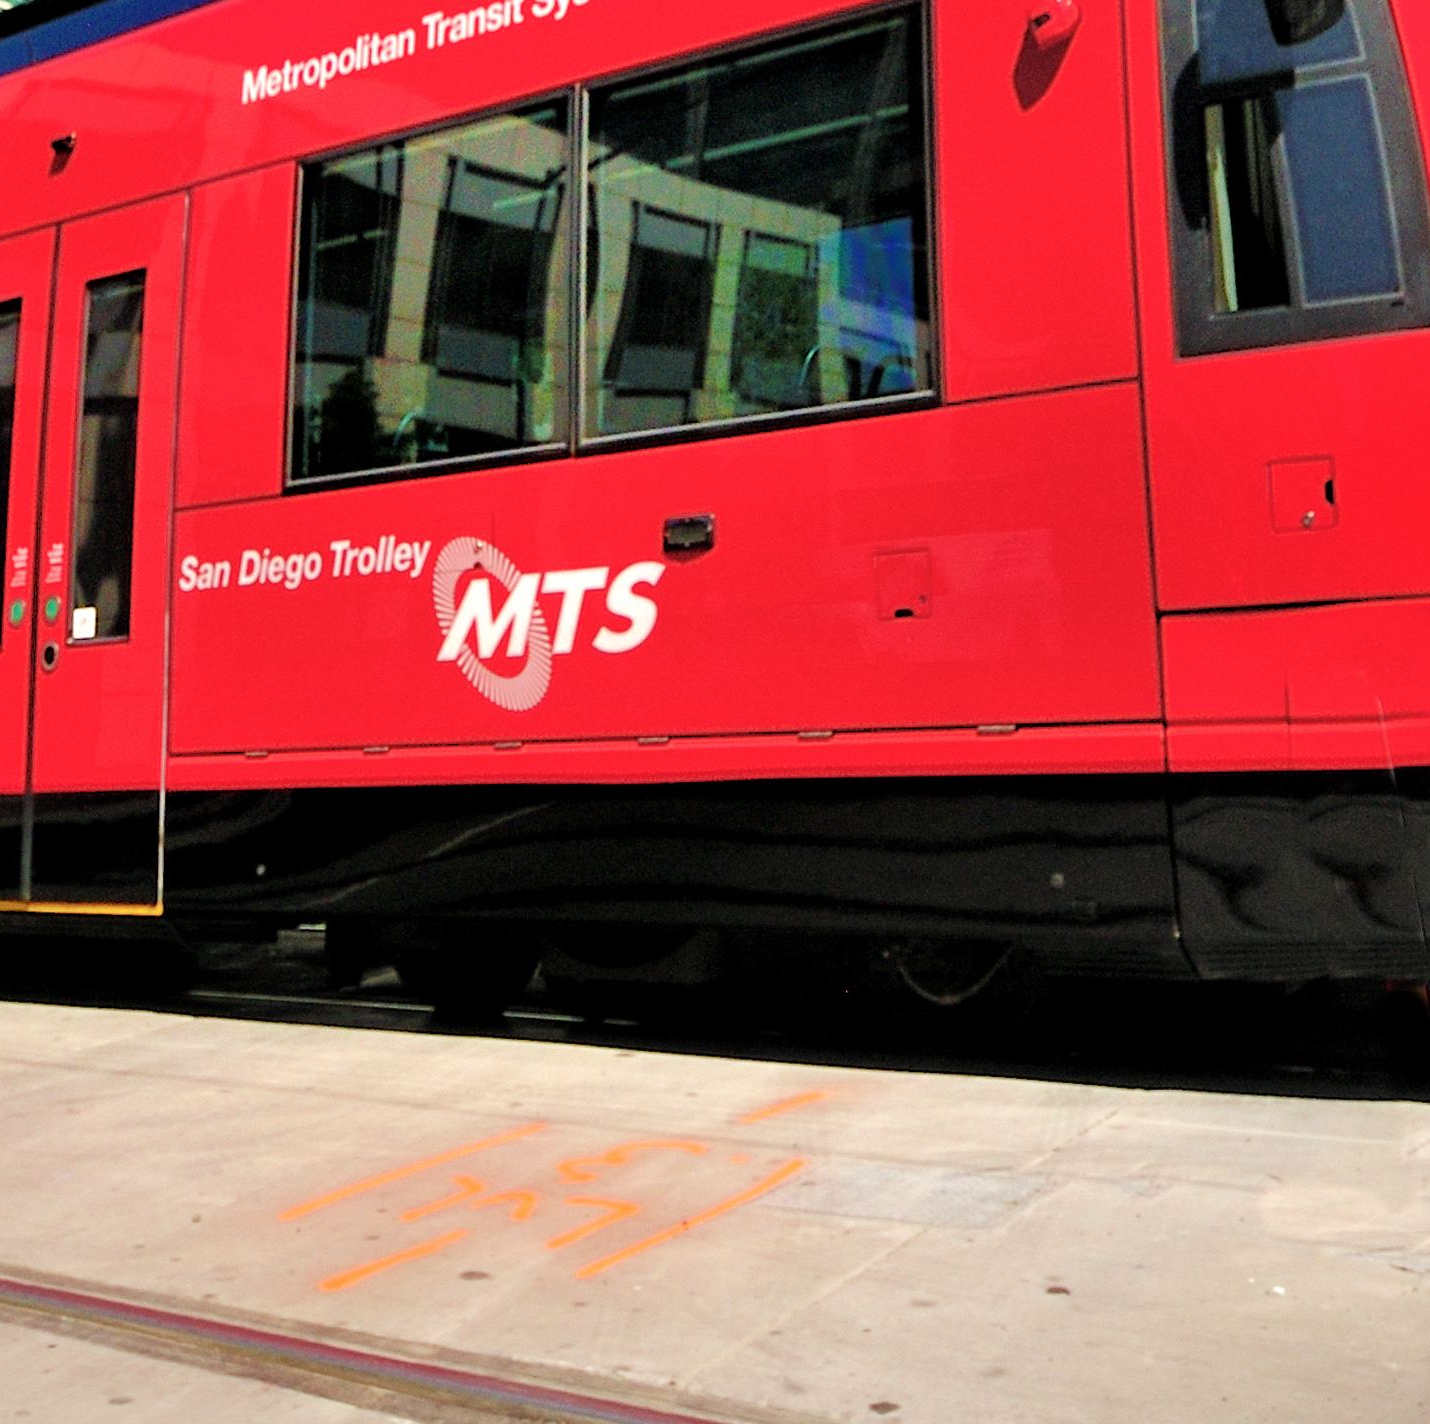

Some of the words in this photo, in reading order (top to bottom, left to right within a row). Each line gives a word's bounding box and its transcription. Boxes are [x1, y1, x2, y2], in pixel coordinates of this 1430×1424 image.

[241, 28, 416, 105] Metropolitan
[178, 554, 230, 592] San
[237, 545, 323, 592] Diego
[329, 534, 432, 580] Trolley
[436, 560, 666, 663] MTS
